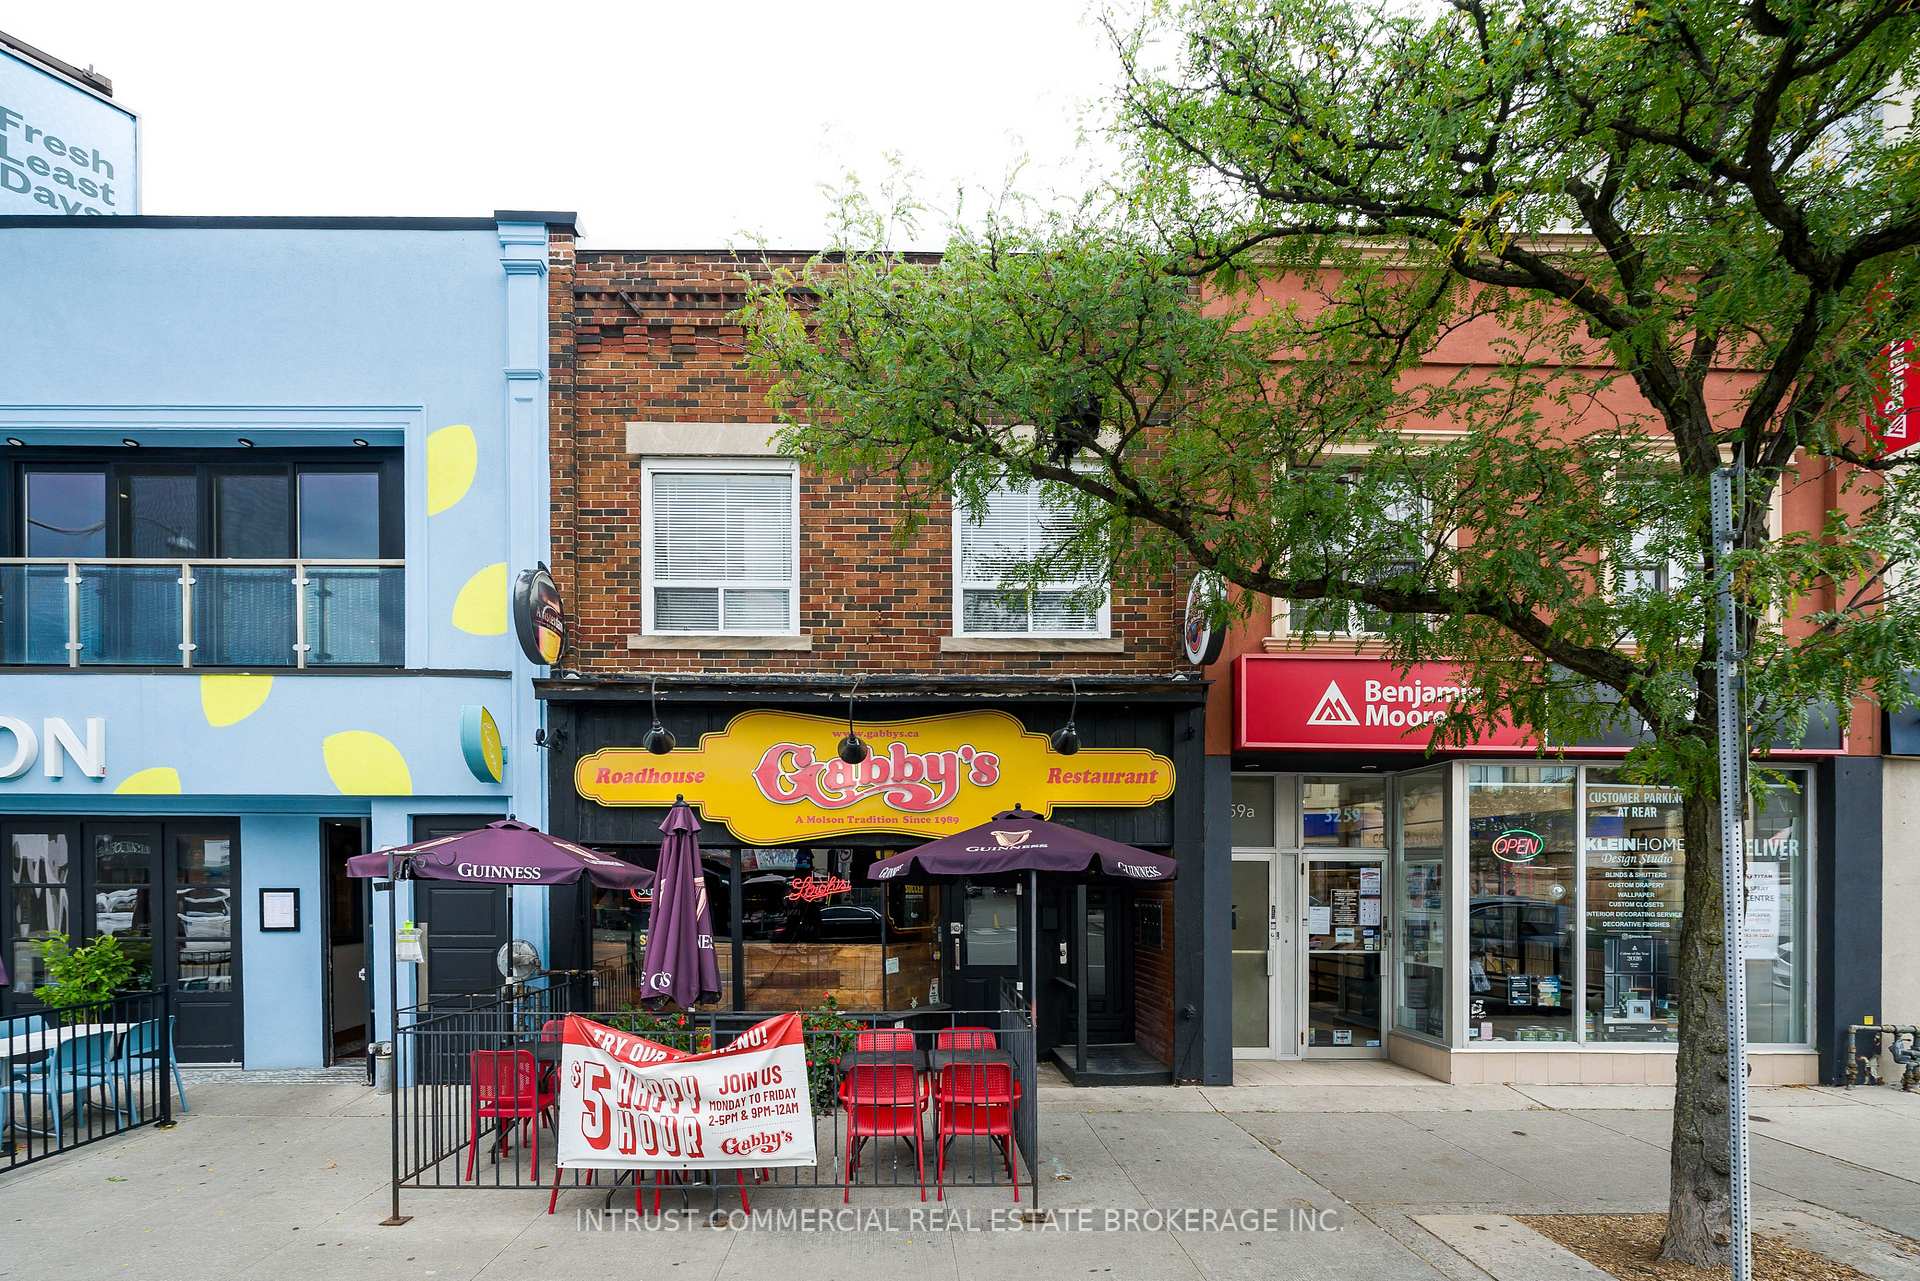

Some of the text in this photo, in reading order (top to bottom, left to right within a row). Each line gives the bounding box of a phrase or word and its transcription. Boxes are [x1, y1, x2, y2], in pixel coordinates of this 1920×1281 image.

[0, 104, 115, 181] Fresh
[0, 133, 116, 207] Least
[1365, 705, 1447, 727] Moore
[831, 730, 920, 740] www.gabbys.ca
[595, 767, 706, 785] Roadhouse
[752, 740, 1001, 814] Gabby's
[1046, 767, 1160, 785] Restaurant
[1589, 792, 1640, 803] CUSTOMER
[795, 815, 960, 825] A Molson Tradition Since 1989
[1324, 807, 1361, 823] 3259
[1617, 806, 1657, 818] AT REAR
[1495, 838, 1540, 855] OPEN
[1584, 837, 1686, 851] KLEINHOME
[1745, 838, 1800, 857] ELIVER
[1601, 851, 1673, 867] Design Studio
[457, 862, 541, 880] GUINNESS
[1634, 871, 1668, 879] SHUTTERS
[593, 1028, 667, 1062] TRY OUR
[712, 1026, 768, 1055] ENU!
[616, 1066, 702, 1114] HAPPY
[718, 1065, 783, 1096] JOIN US
[708, 1087, 797, 1111] MONDAY TO FRIDAY
[708, 1102, 799, 1127] 2-5PM & 9PM-12AM
[616, 1109, 704, 1158] HOUR
[720, 1129, 793, 1156] Gabby's
